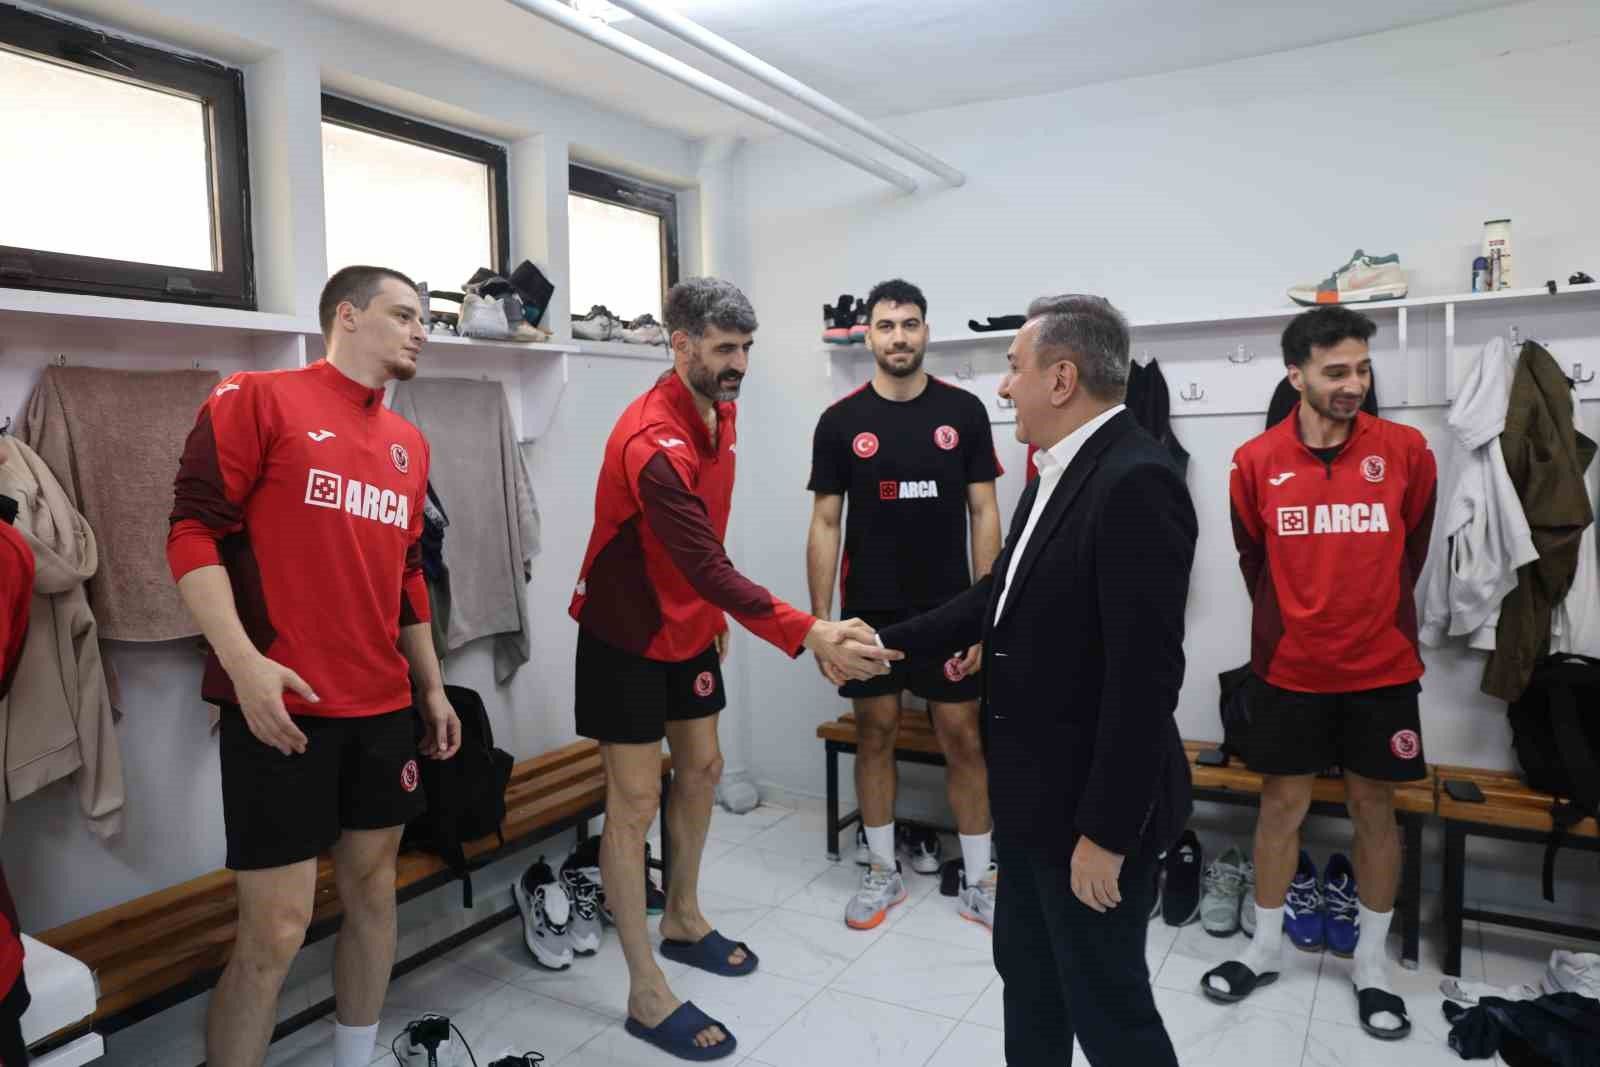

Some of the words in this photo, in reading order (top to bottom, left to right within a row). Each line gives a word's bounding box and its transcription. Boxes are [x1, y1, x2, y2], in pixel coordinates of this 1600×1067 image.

[345, 480, 408, 530] ARCA
[899, 480, 938, 499] ARCA
[1313, 503, 1390, 534] ARCA
